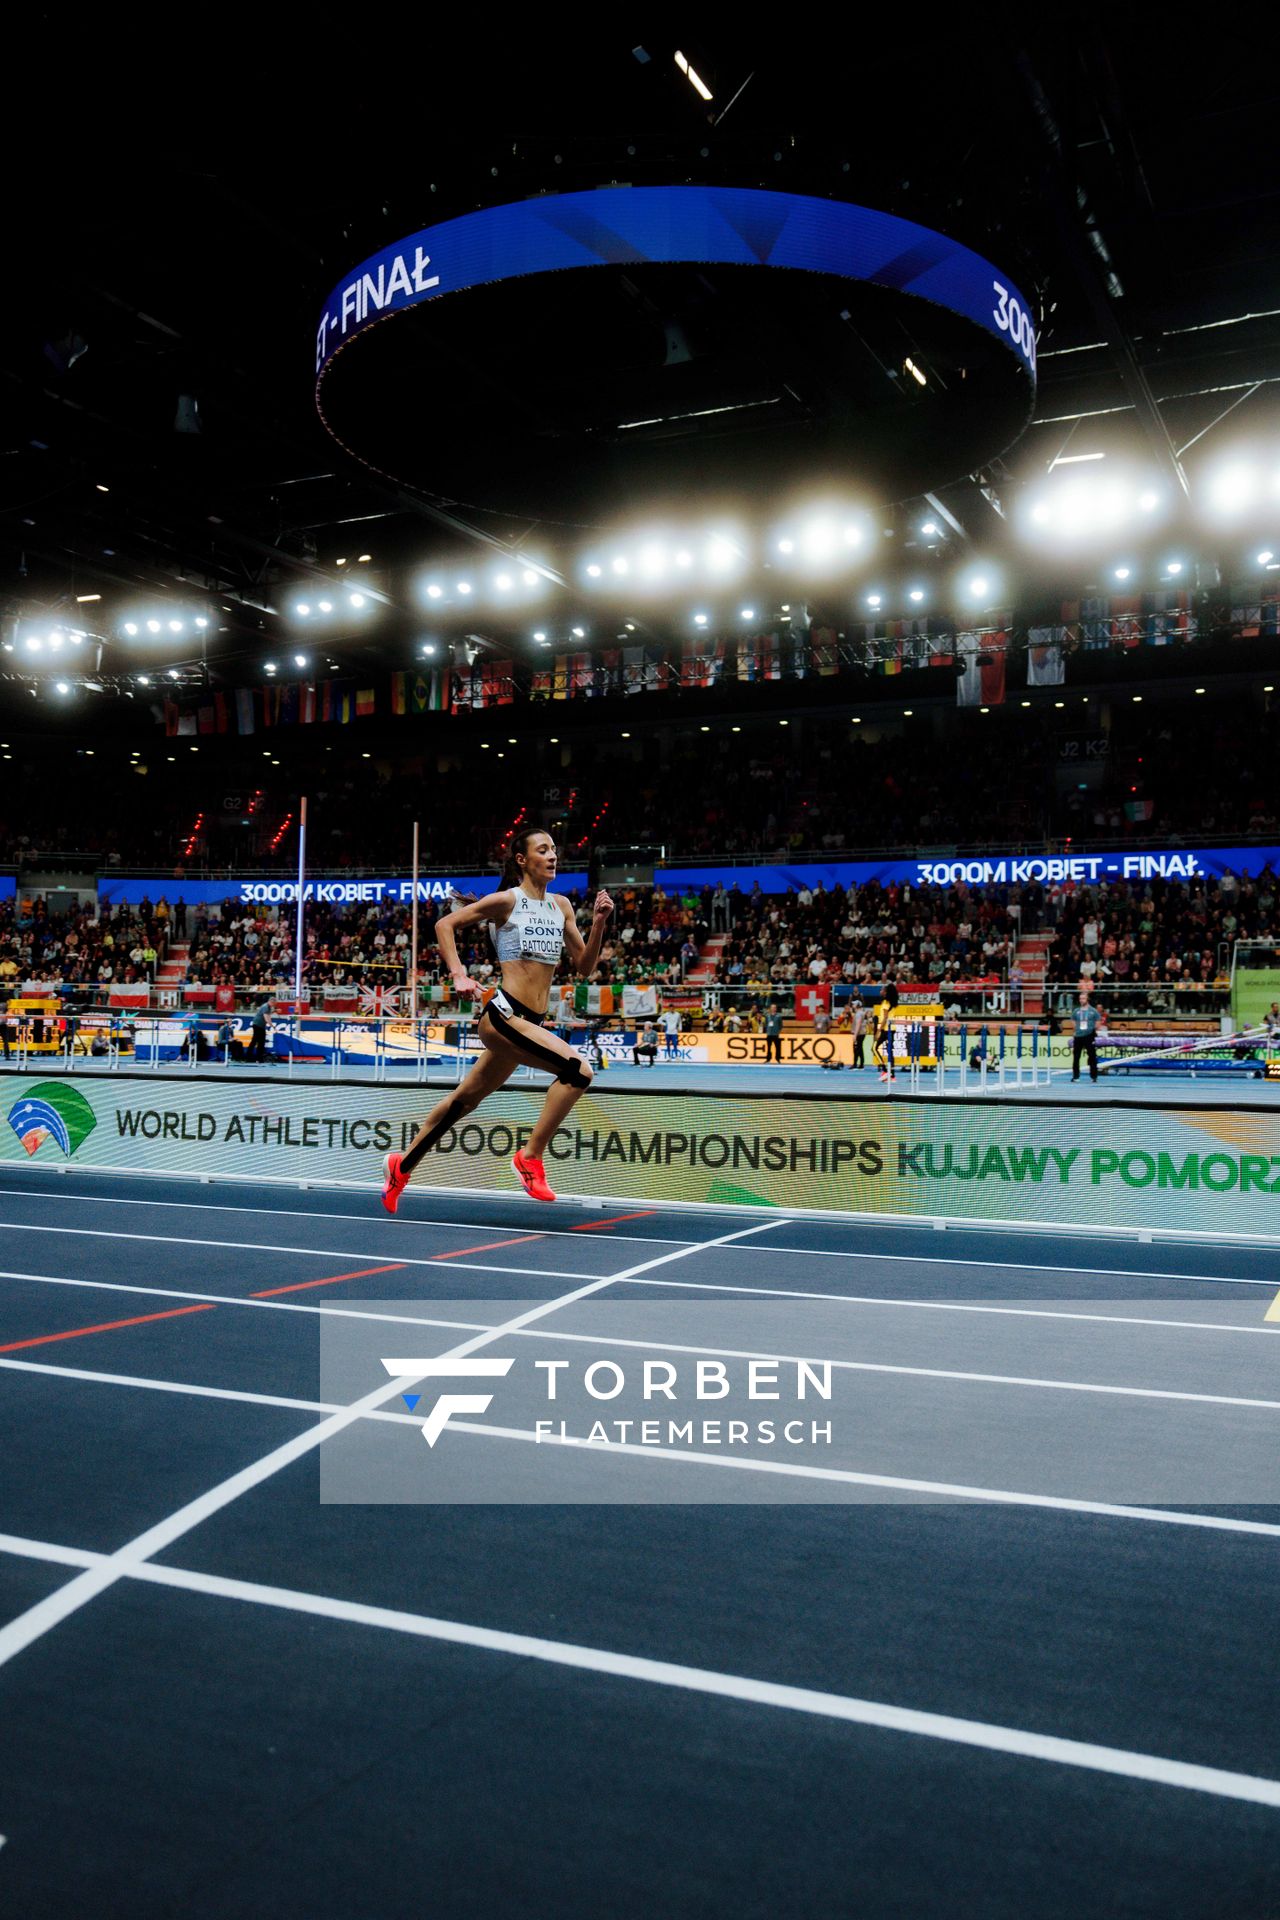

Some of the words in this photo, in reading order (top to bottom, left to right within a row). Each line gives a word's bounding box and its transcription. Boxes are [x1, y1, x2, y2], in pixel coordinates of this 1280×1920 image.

[342, 246, 440, 334] FINAŁ
[993, 280, 1036, 373] 3000
[917, 861, 1006, 885] 3000M
[1011, 858, 1102, 882] KOBIET
[1123, 855, 1204, 879] FINAŁ
[240, 884, 313, 902] 3000M
[317, 883, 386, 901] KOBIET
[524, 926, 564, 937] SONY
[986, 992, 1006, 1009] J1
[390, 1026, 437, 1039] SEO
[727, 1037, 836, 1060] SEKO
[116, 1110, 217, 1141] WORLD
[224, 1115, 393, 1150] ATHLETICS
[549, 1127, 884, 1176] CHAMPIONSHIPS
[897, 1142, 1081, 1184] KUJAWY
